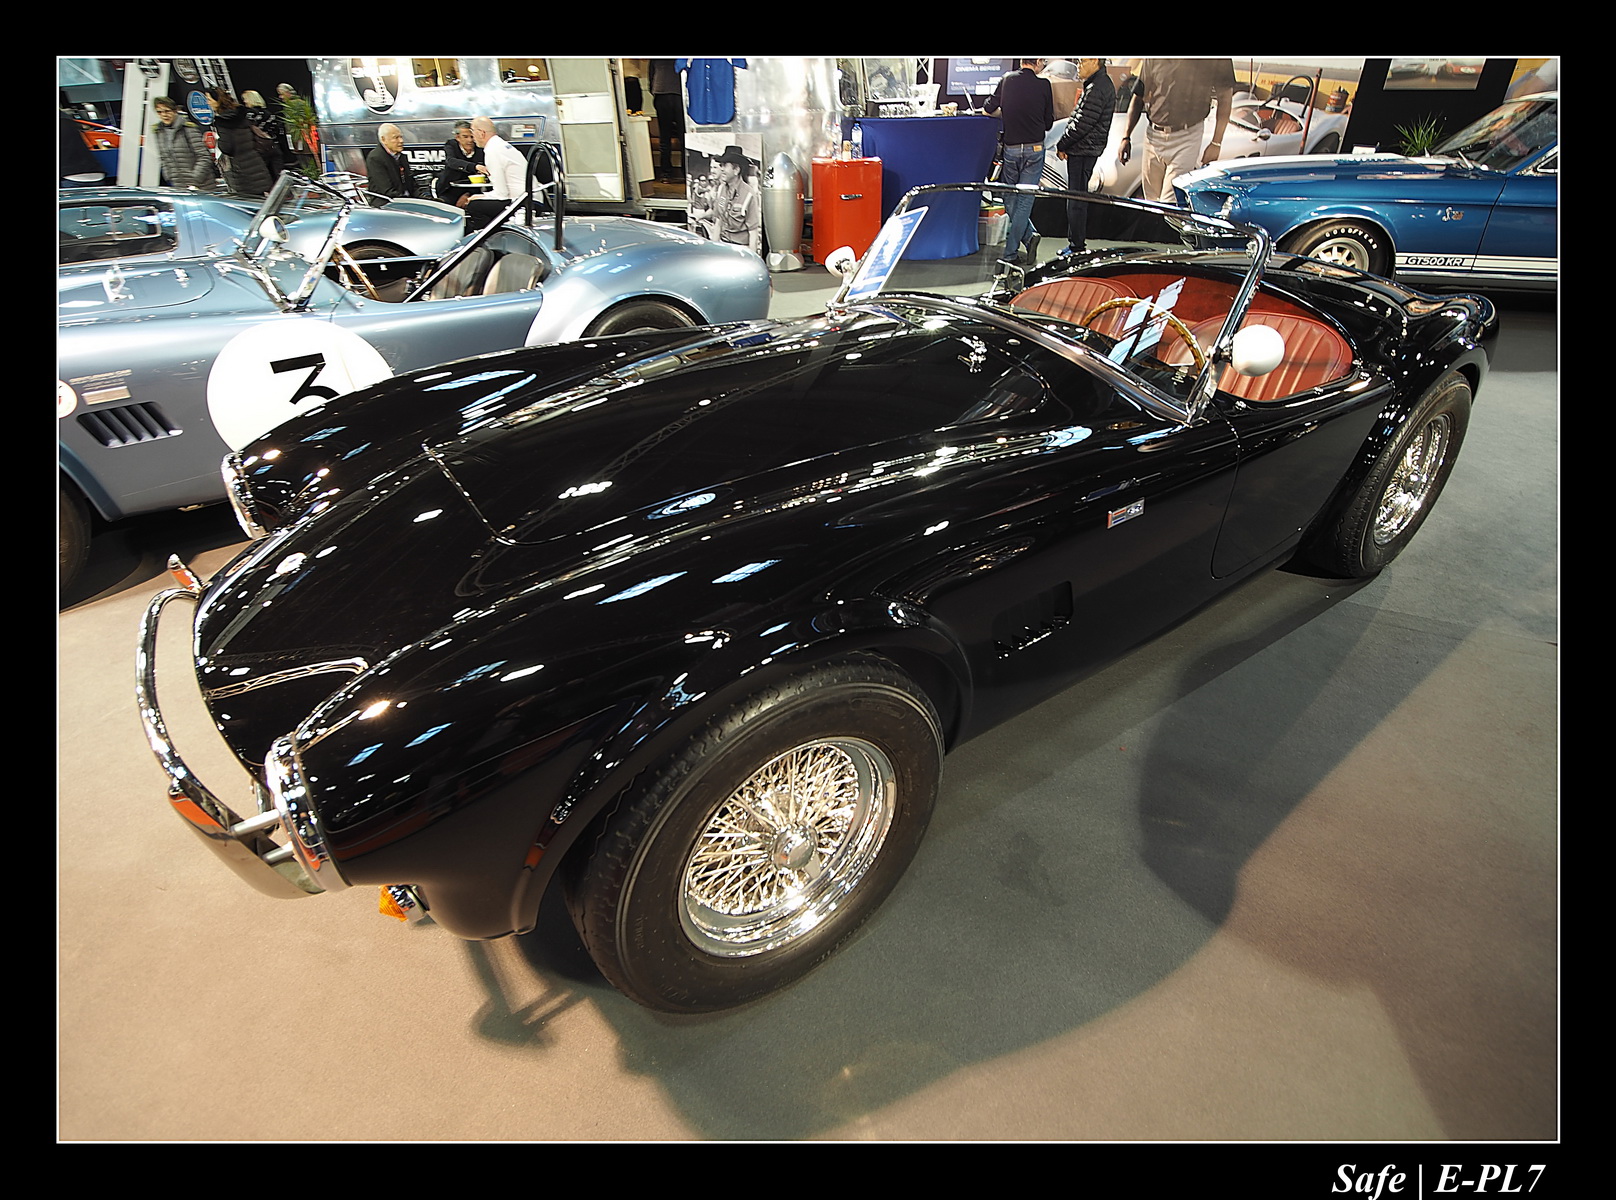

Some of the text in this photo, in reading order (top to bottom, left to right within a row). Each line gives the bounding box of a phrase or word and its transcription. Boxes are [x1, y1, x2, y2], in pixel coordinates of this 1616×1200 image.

[1325, 228, 1378, 250] GOODYEAR
[1408, 256, 1463, 267] GT500 KR
